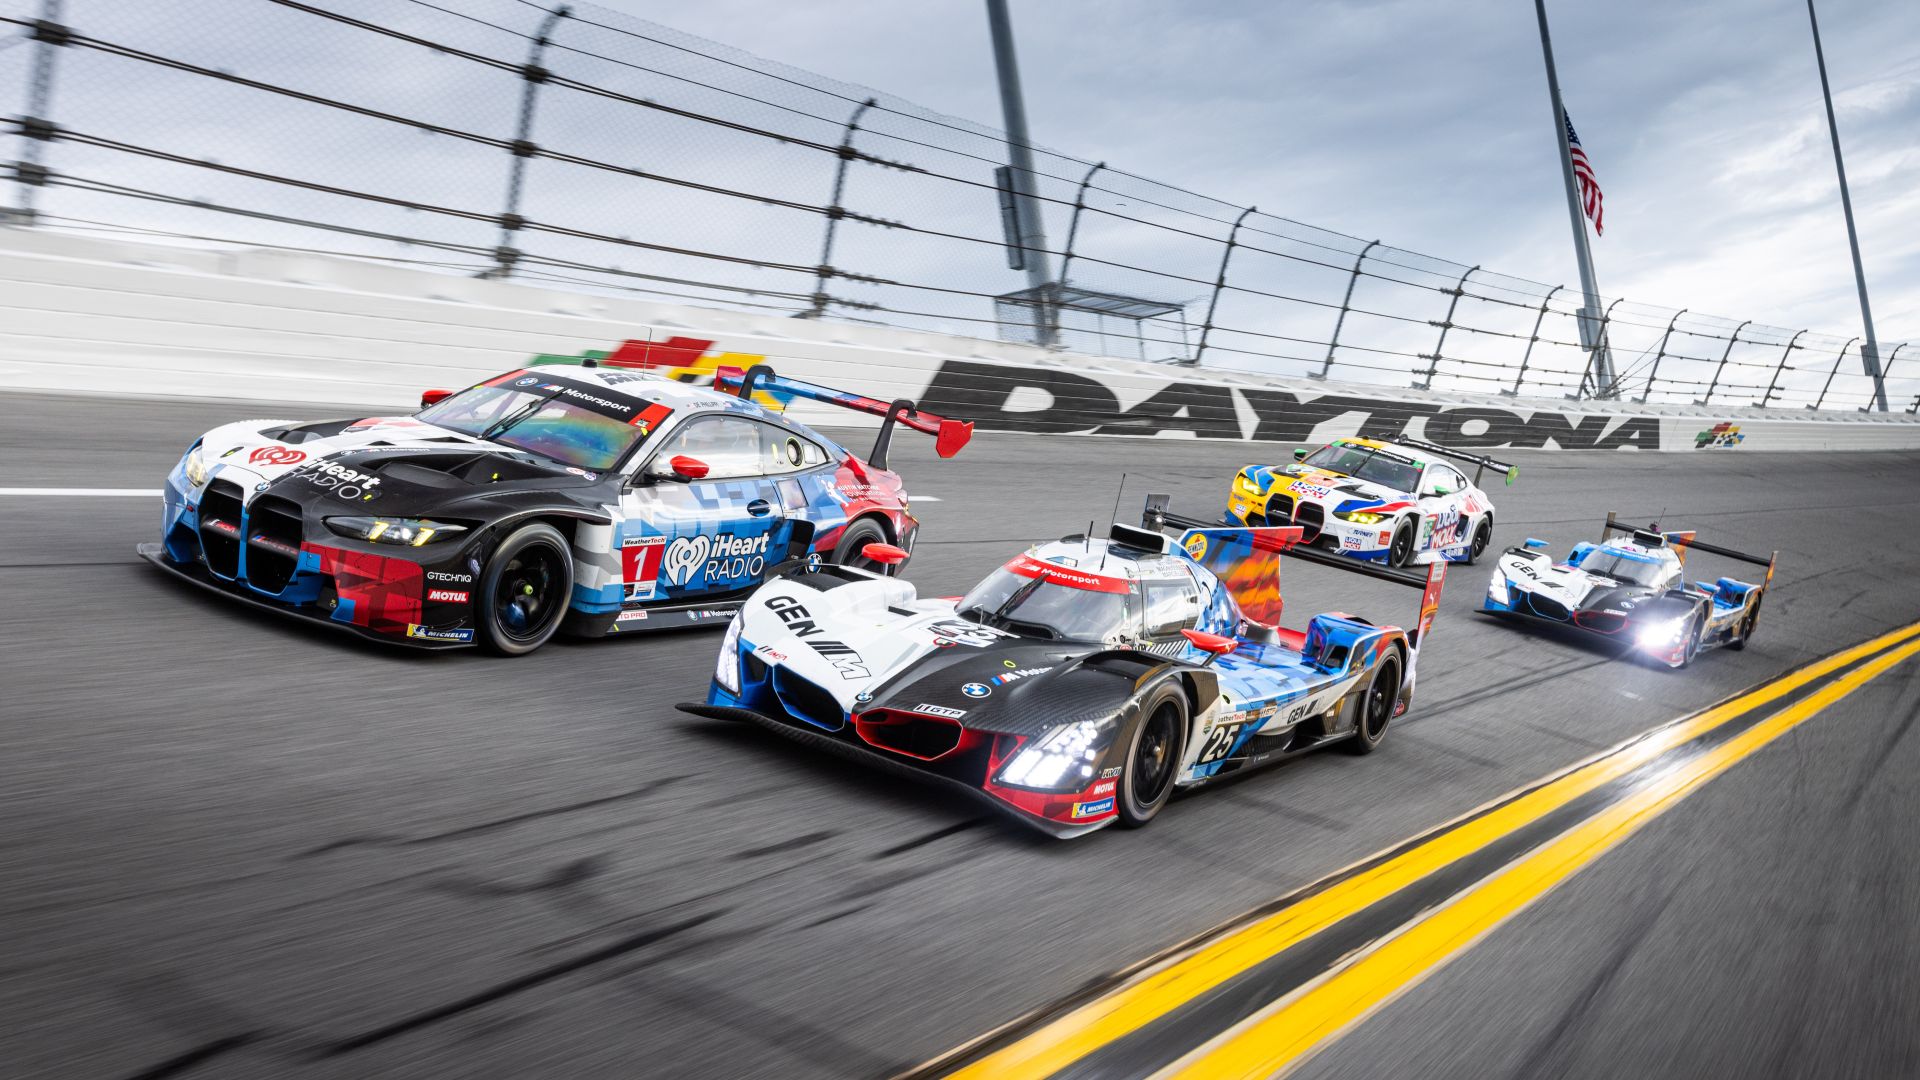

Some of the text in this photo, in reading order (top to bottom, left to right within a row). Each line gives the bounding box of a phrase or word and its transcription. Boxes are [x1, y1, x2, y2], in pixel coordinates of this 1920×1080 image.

[564, 387, 631, 413] Motorsport
[915, 360, 1660, 450] DAYTONA
[300, 457, 382, 489] iHeart
[284, 470, 362, 499] RADIO
[624, 537, 666, 546] WeatherTech
[710, 532, 770, 558] iHeart
[633, 546, 649, 581] 1
[704, 555, 764, 582] RADIO
[1510, 561, 1543, 581] GEN
[427, 571, 472, 583] GTECHNIQ
[1041, 568, 1101, 585] Motorsport
[430, 590, 467, 602] MOTUL
[764, 595, 826, 638] GEN
[428, 631, 469, 639] MICHELIN
[929, 706, 962, 717] GTP
[1218, 713, 1245, 723] atherTech
[1286, 703, 1307, 725] GEN
[1201, 725, 1240, 763] 25
[1093, 782, 1115, 795] MOTUL
